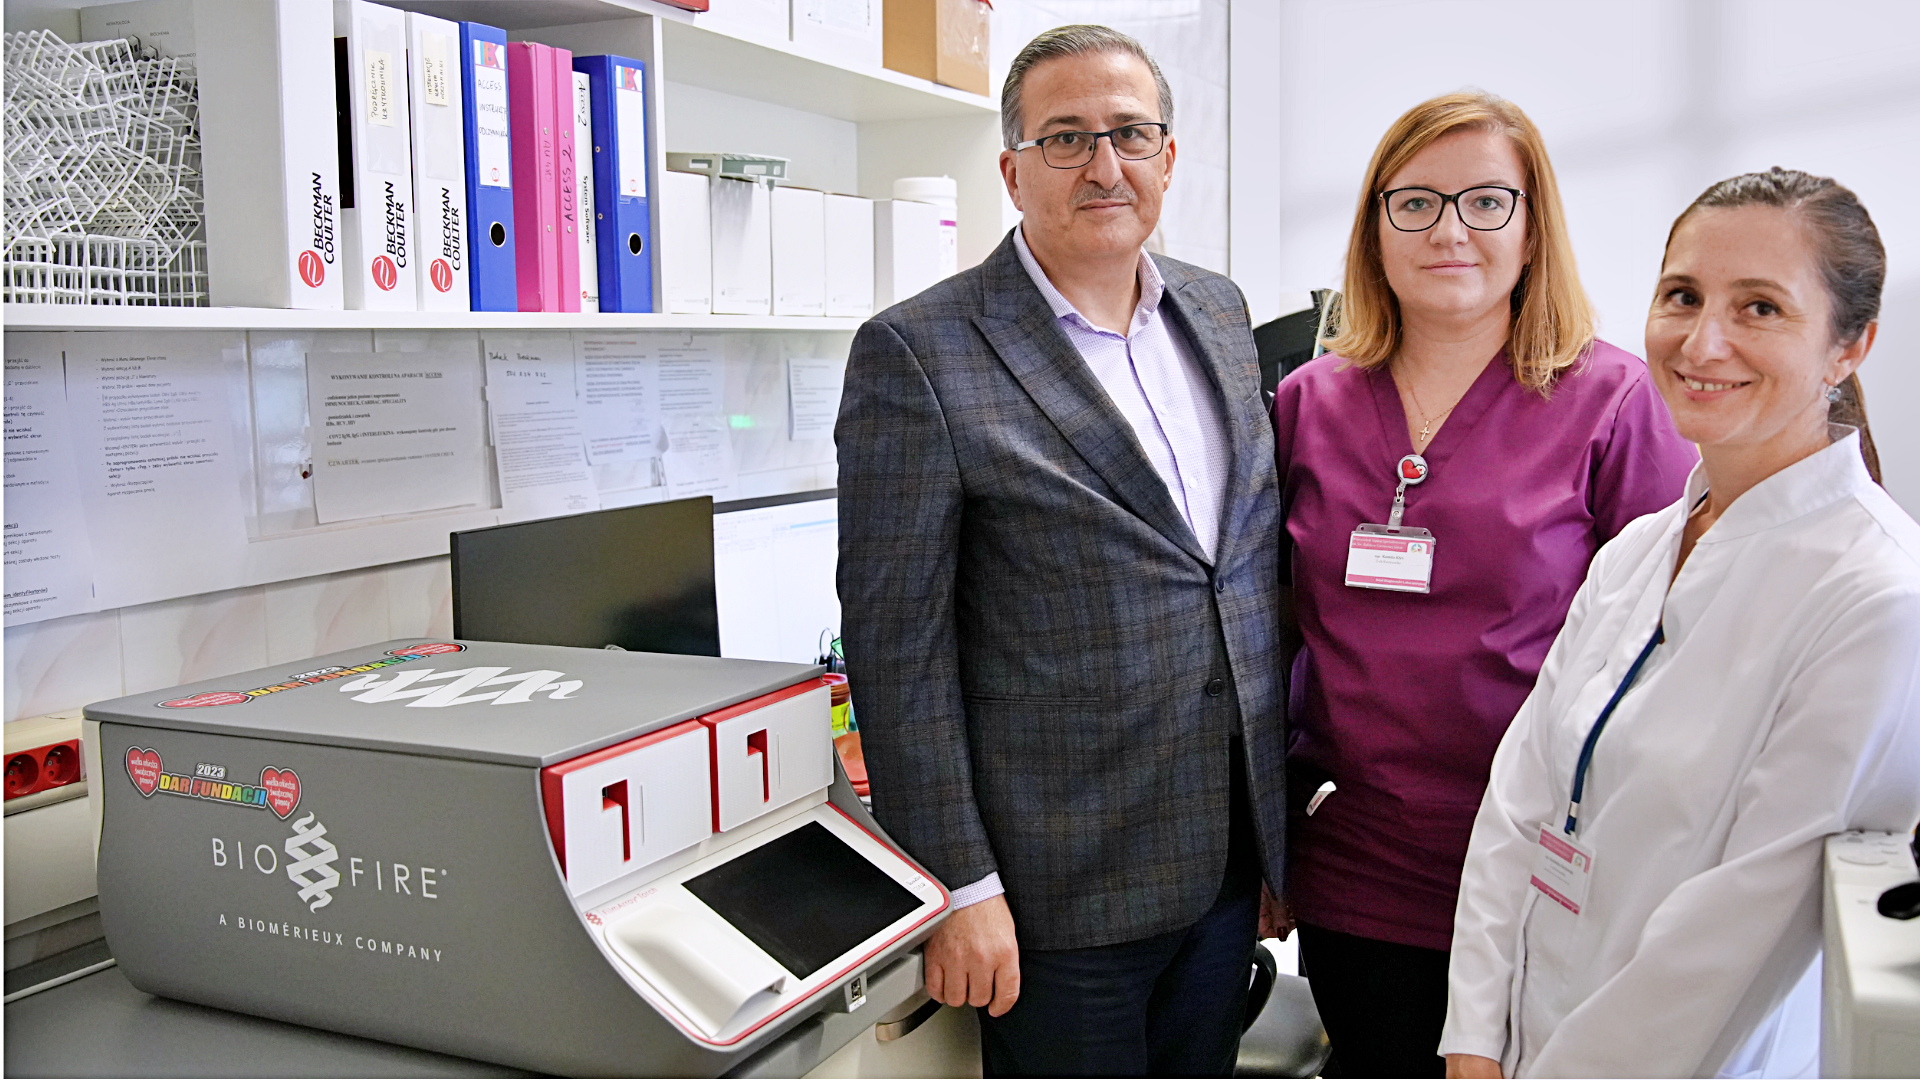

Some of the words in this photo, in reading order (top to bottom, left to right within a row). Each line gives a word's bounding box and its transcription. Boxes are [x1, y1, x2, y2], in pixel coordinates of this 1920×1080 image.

[478, 79, 502, 91] ACCESS
[578, 114, 587, 127] 2
[562, 144, 573, 163] 2
[312, 172, 324, 250] BECKMAN
[384, 180, 397, 256] BECKMAN
[562, 167, 574, 222] ACCESS
[323, 194, 335, 264] COULTER
[396, 202, 406, 268] COULTER
[441, 186, 452, 258] BECKMAN
[452, 207, 461, 271] COULTER
[306, 654, 422, 684] FUNDACJI
[160, 774, 191, 793] DAR
[192, 780, 267, 806] FUNDACJI
[198, 764, 225, 778] 2023
[212, 837, 278, 874] BIO
[219, 914, 227, 926] A
[238, 916, 343, 946] BIOMÉRIEUX
[355, 936, 442, 962] COMPANY
